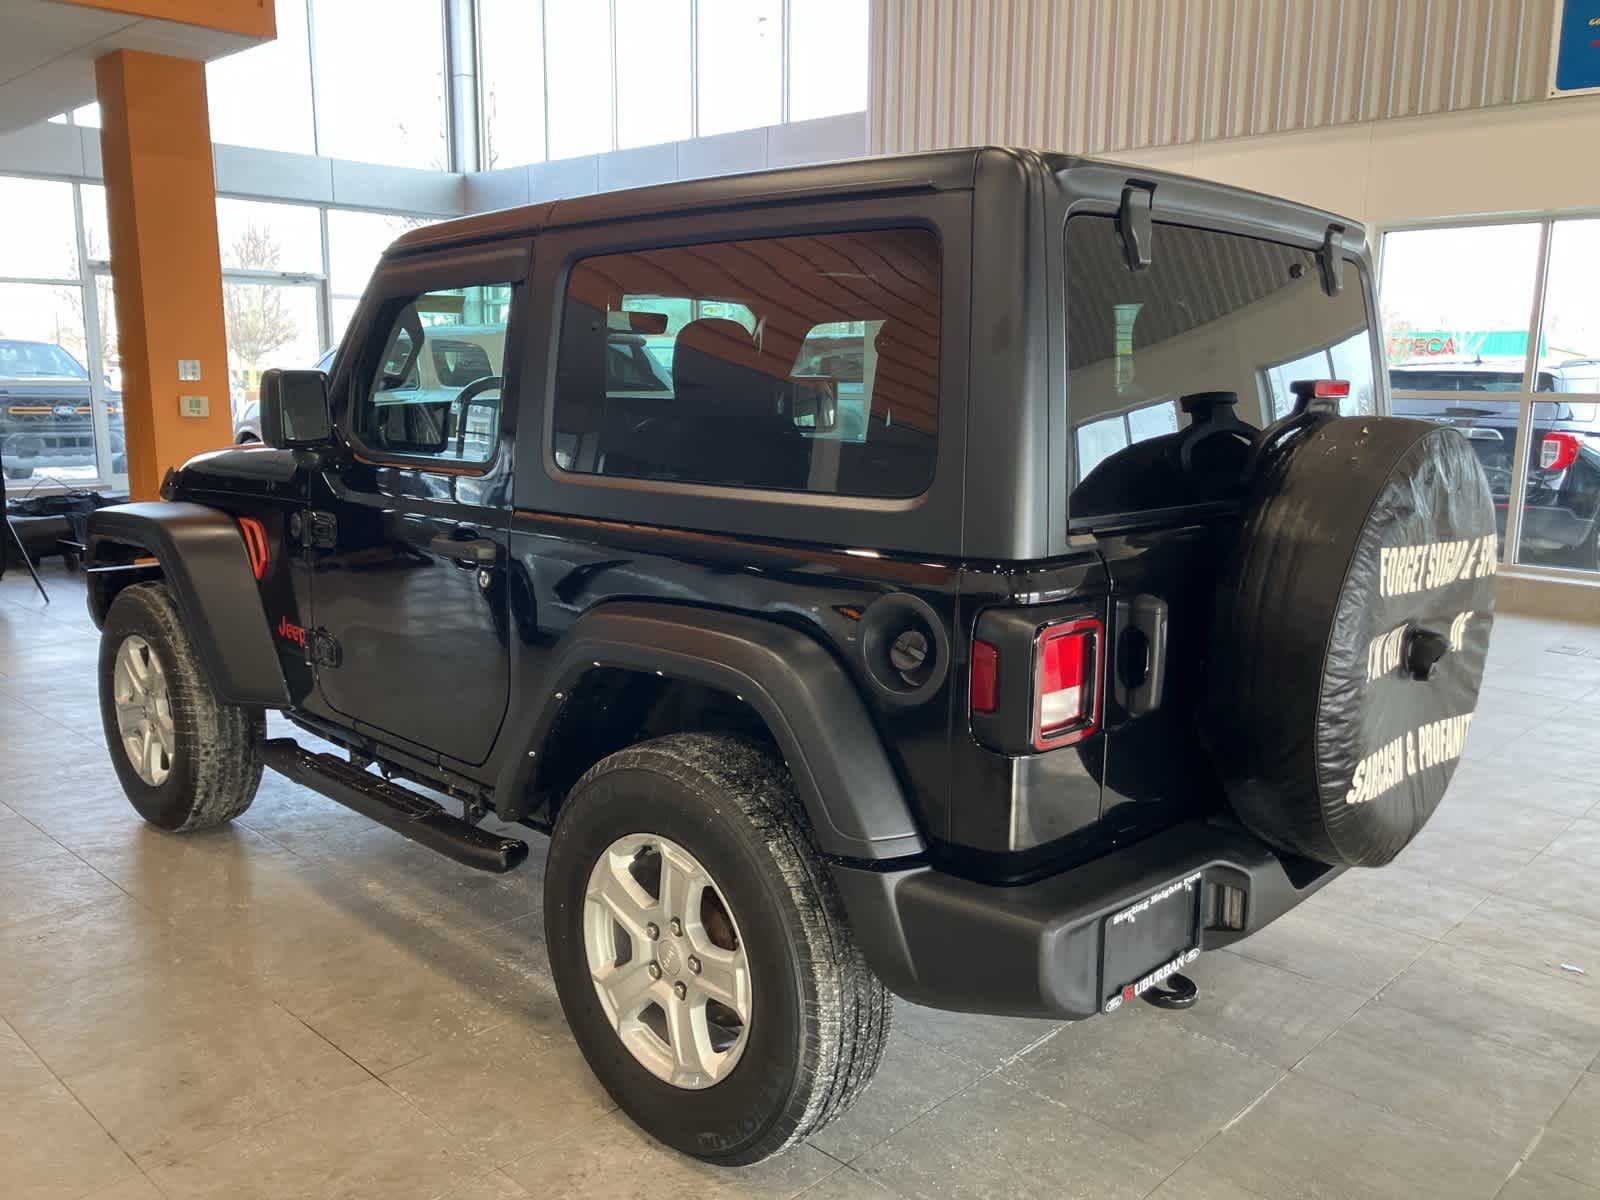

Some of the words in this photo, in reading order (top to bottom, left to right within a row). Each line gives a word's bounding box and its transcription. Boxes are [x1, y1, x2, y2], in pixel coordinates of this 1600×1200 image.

[1380, 545, 1429, 598] FORGET
[1426, 540, 1469, 590] SUGAR
[1459, 538, 1480, 580] &
[276, 613, 298, 640] Jeep
[1449, 610, 1475, 652] OF
[1345, 735, 1404, 804] SARCASM
[1406, 729, 1417, 777] &
[1418, 711, 1475, 772] PROFANIT
[1122, 954, 1185, 1002] SUBURBAN
